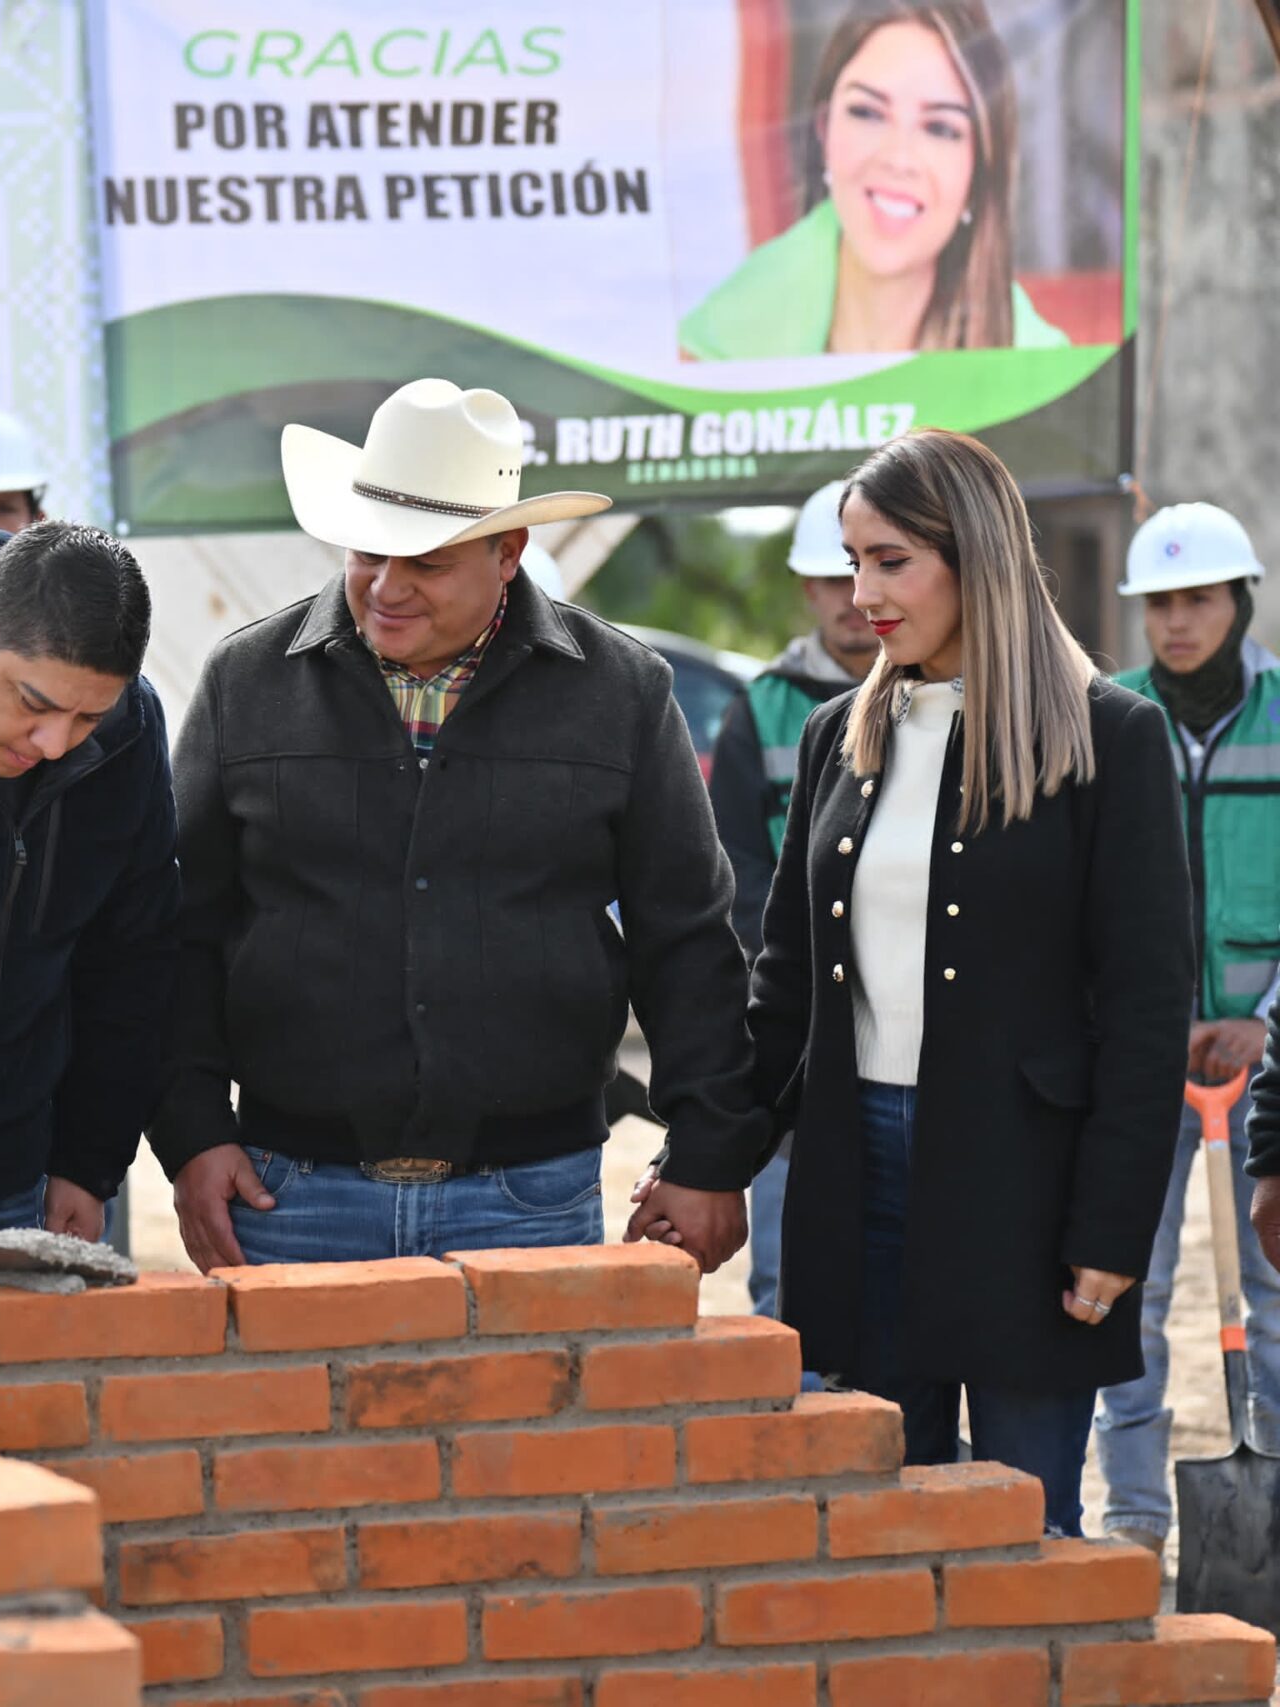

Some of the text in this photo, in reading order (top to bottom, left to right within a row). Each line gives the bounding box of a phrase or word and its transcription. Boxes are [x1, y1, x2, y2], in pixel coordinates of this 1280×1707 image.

[183, 28, 566, 78] GRACIAS
[175, 100, 558, 149] POR ATENDER
[104, 160, 649, 226] NUESTRA PETICIÓN
[556, 413, 684, 464] RUTH
[690, 400, 916, 456] GONZÁLEZ
